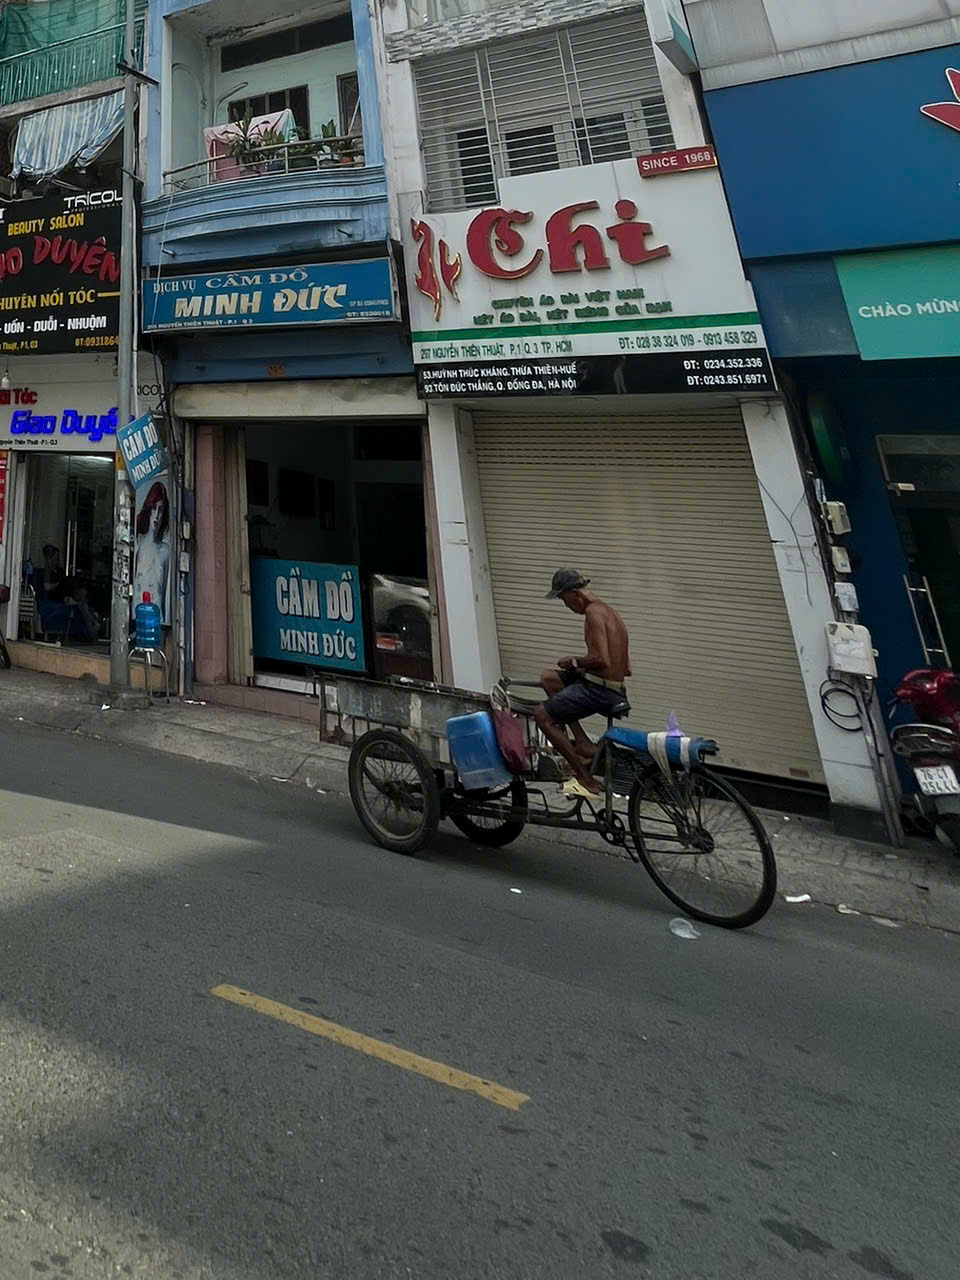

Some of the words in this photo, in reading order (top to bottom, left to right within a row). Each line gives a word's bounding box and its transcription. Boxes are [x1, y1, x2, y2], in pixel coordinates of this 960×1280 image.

[642, 156, 678, 170] SINCE
[684, 151, 711, 164] 1968
[7, 218, 45, 237] BEAUTY
[49, 212, 85, 231] SALON
[466, 199, 672, 280] Chi
[33, 234, 121, 284] DUYÊN
[153, 281, 180, 296] DỊCH
[182, 280, 197, 294] VỤ
[205, 272, 263, 289] CẦM
[40, 287, 64, 308] NỐI
[68, 286, 96, 305] TÓC
[174, 290, 262, 318] MINH
[273, 282, 347, 313] ĐỨC
[540, 294, 556, 306] ÁO
[560, 292, 581, 305] DÀI
[584, 289, 611, 303] VIỆT
[616, 288, 645, 300] NAM
[858, 302, 912, 318] CHÀO
[916, 298, 960, 314] MỪN
[4, 317, 25, 333] UỐN
[67, 314, 107, 332] NHUỘM
[500, 311, 515, 323] ÁO
[432, 342, 460, 359] NGUYỄN
[460, 344, 481, 358] THIỆN
[533, 341, 539, 354] 3
[541, 340, 554, 354] TP.
[618, 337, 635, 350] ĐT:
[635, 336, 651, 349] 028
[652, 335, 662, 347] 38
[663, 334, 679, 347] 324
[680, 333, 695, 346] 019
[702, 332, 723, 346] 0913
[724, 331, 740, 344] 458
[741, 330, 758, 344] 329
[459, 365, 480, 378] THÚC
[511, 362, 533, 376] THỪA
[533, 361, 578, 376] THIÊN-HUẾ
[683, 359, 701, 370] ĐT:
[703, 357, 763, 369] 0234.352.336
[450, 379, 467, 393] ĐỨC
[496, 380, 506, 391] Q.
[507, 377, 531, 391] ĐỐNG
[532, 379, 547, 391] ĐA,
[548, 377, 561, 389] HÀ
[562, 376, 577, 390] NỘI
[10, 409, 57, 436] Giao
[60, 407, 119, 442] Duyê
[123, 428, 147, 461] CẦM
[143, 415, 159, 448] ĐỒ
[132, 458, 152, 483] MINH
[276, 566, 320, 619] CẦM
[325, 570, 355, 623] ĐỒ
[280, 627, 321, 656] MINH
[322, 627, 357, 660] ĐỨC
